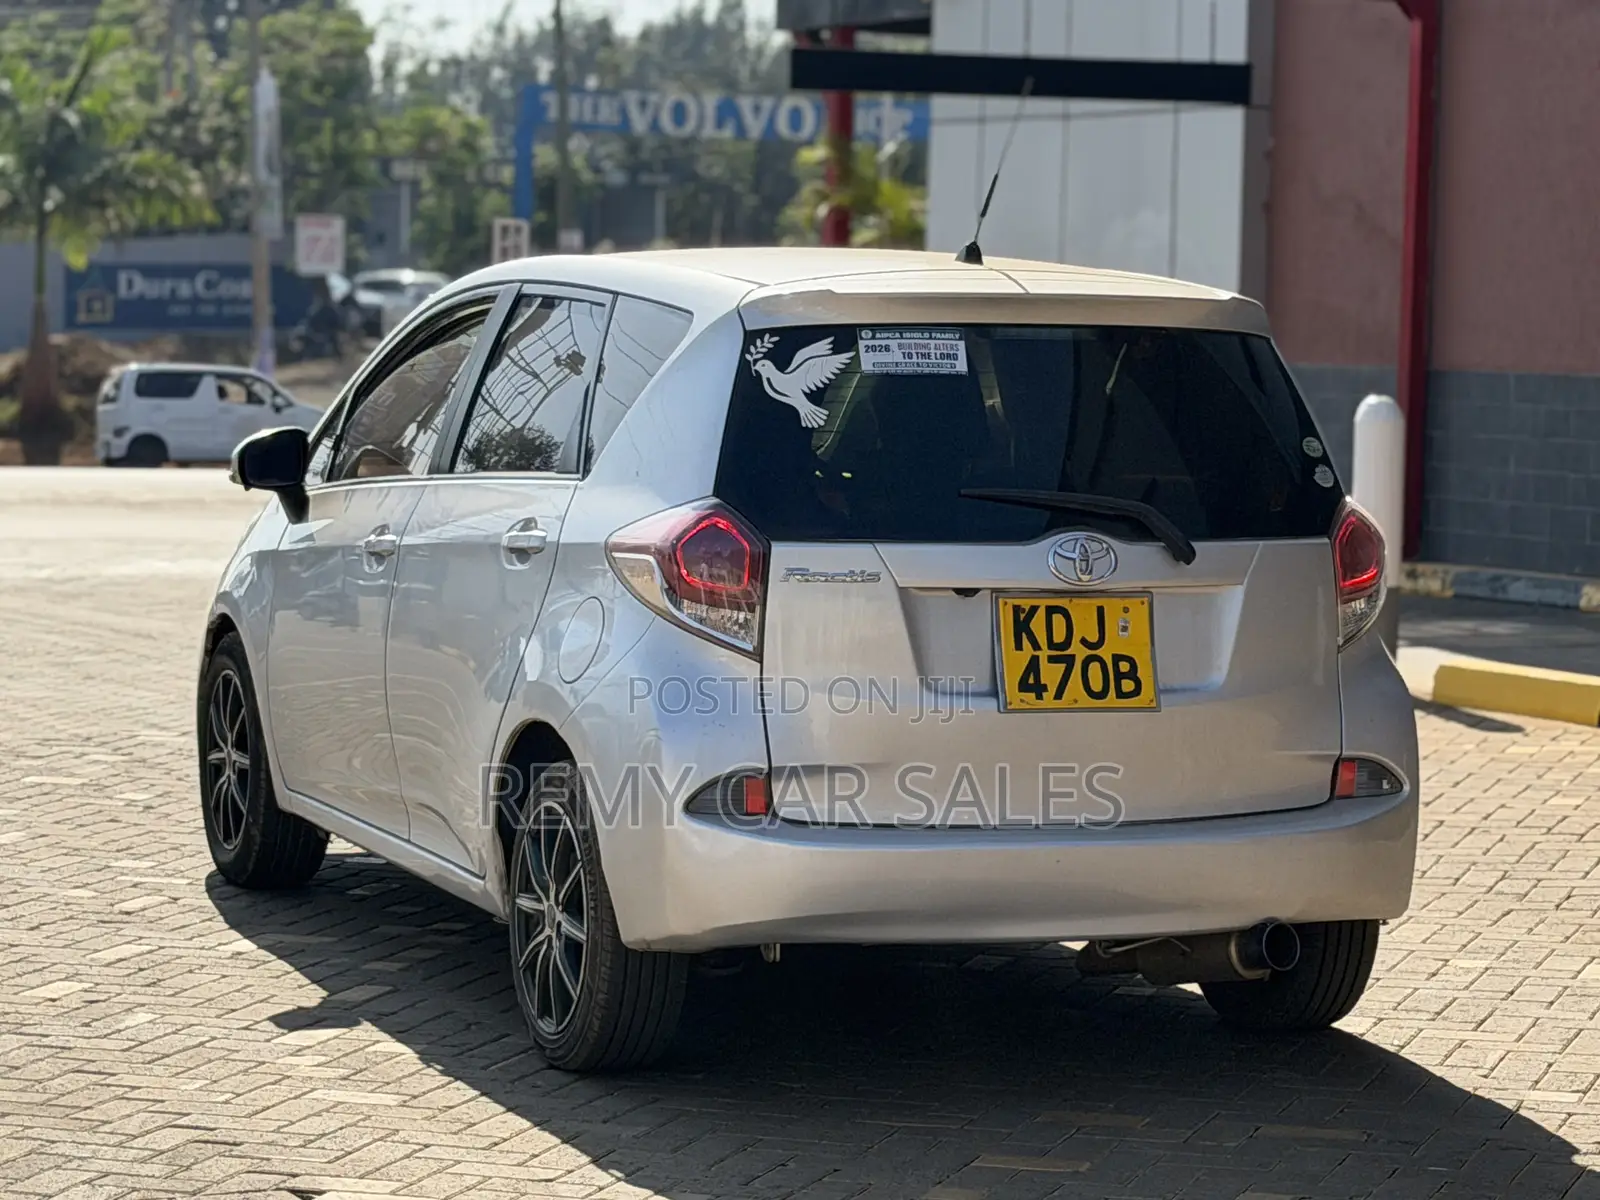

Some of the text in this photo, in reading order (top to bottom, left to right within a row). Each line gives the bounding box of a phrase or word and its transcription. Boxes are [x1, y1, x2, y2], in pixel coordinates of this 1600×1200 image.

[622, 89, 818, 140] VOLVO
[117, 268, 254, 300] DuraCoa
[897, 342, 960, 352] BUILDING ALTERS
[931, 332, 961, 340] FAMILY
[901, 351, 959, 361] TO THE LORD
[1012, 604, 1106, 652] KDJ
[1017, 653, 1143, 701] 470B
